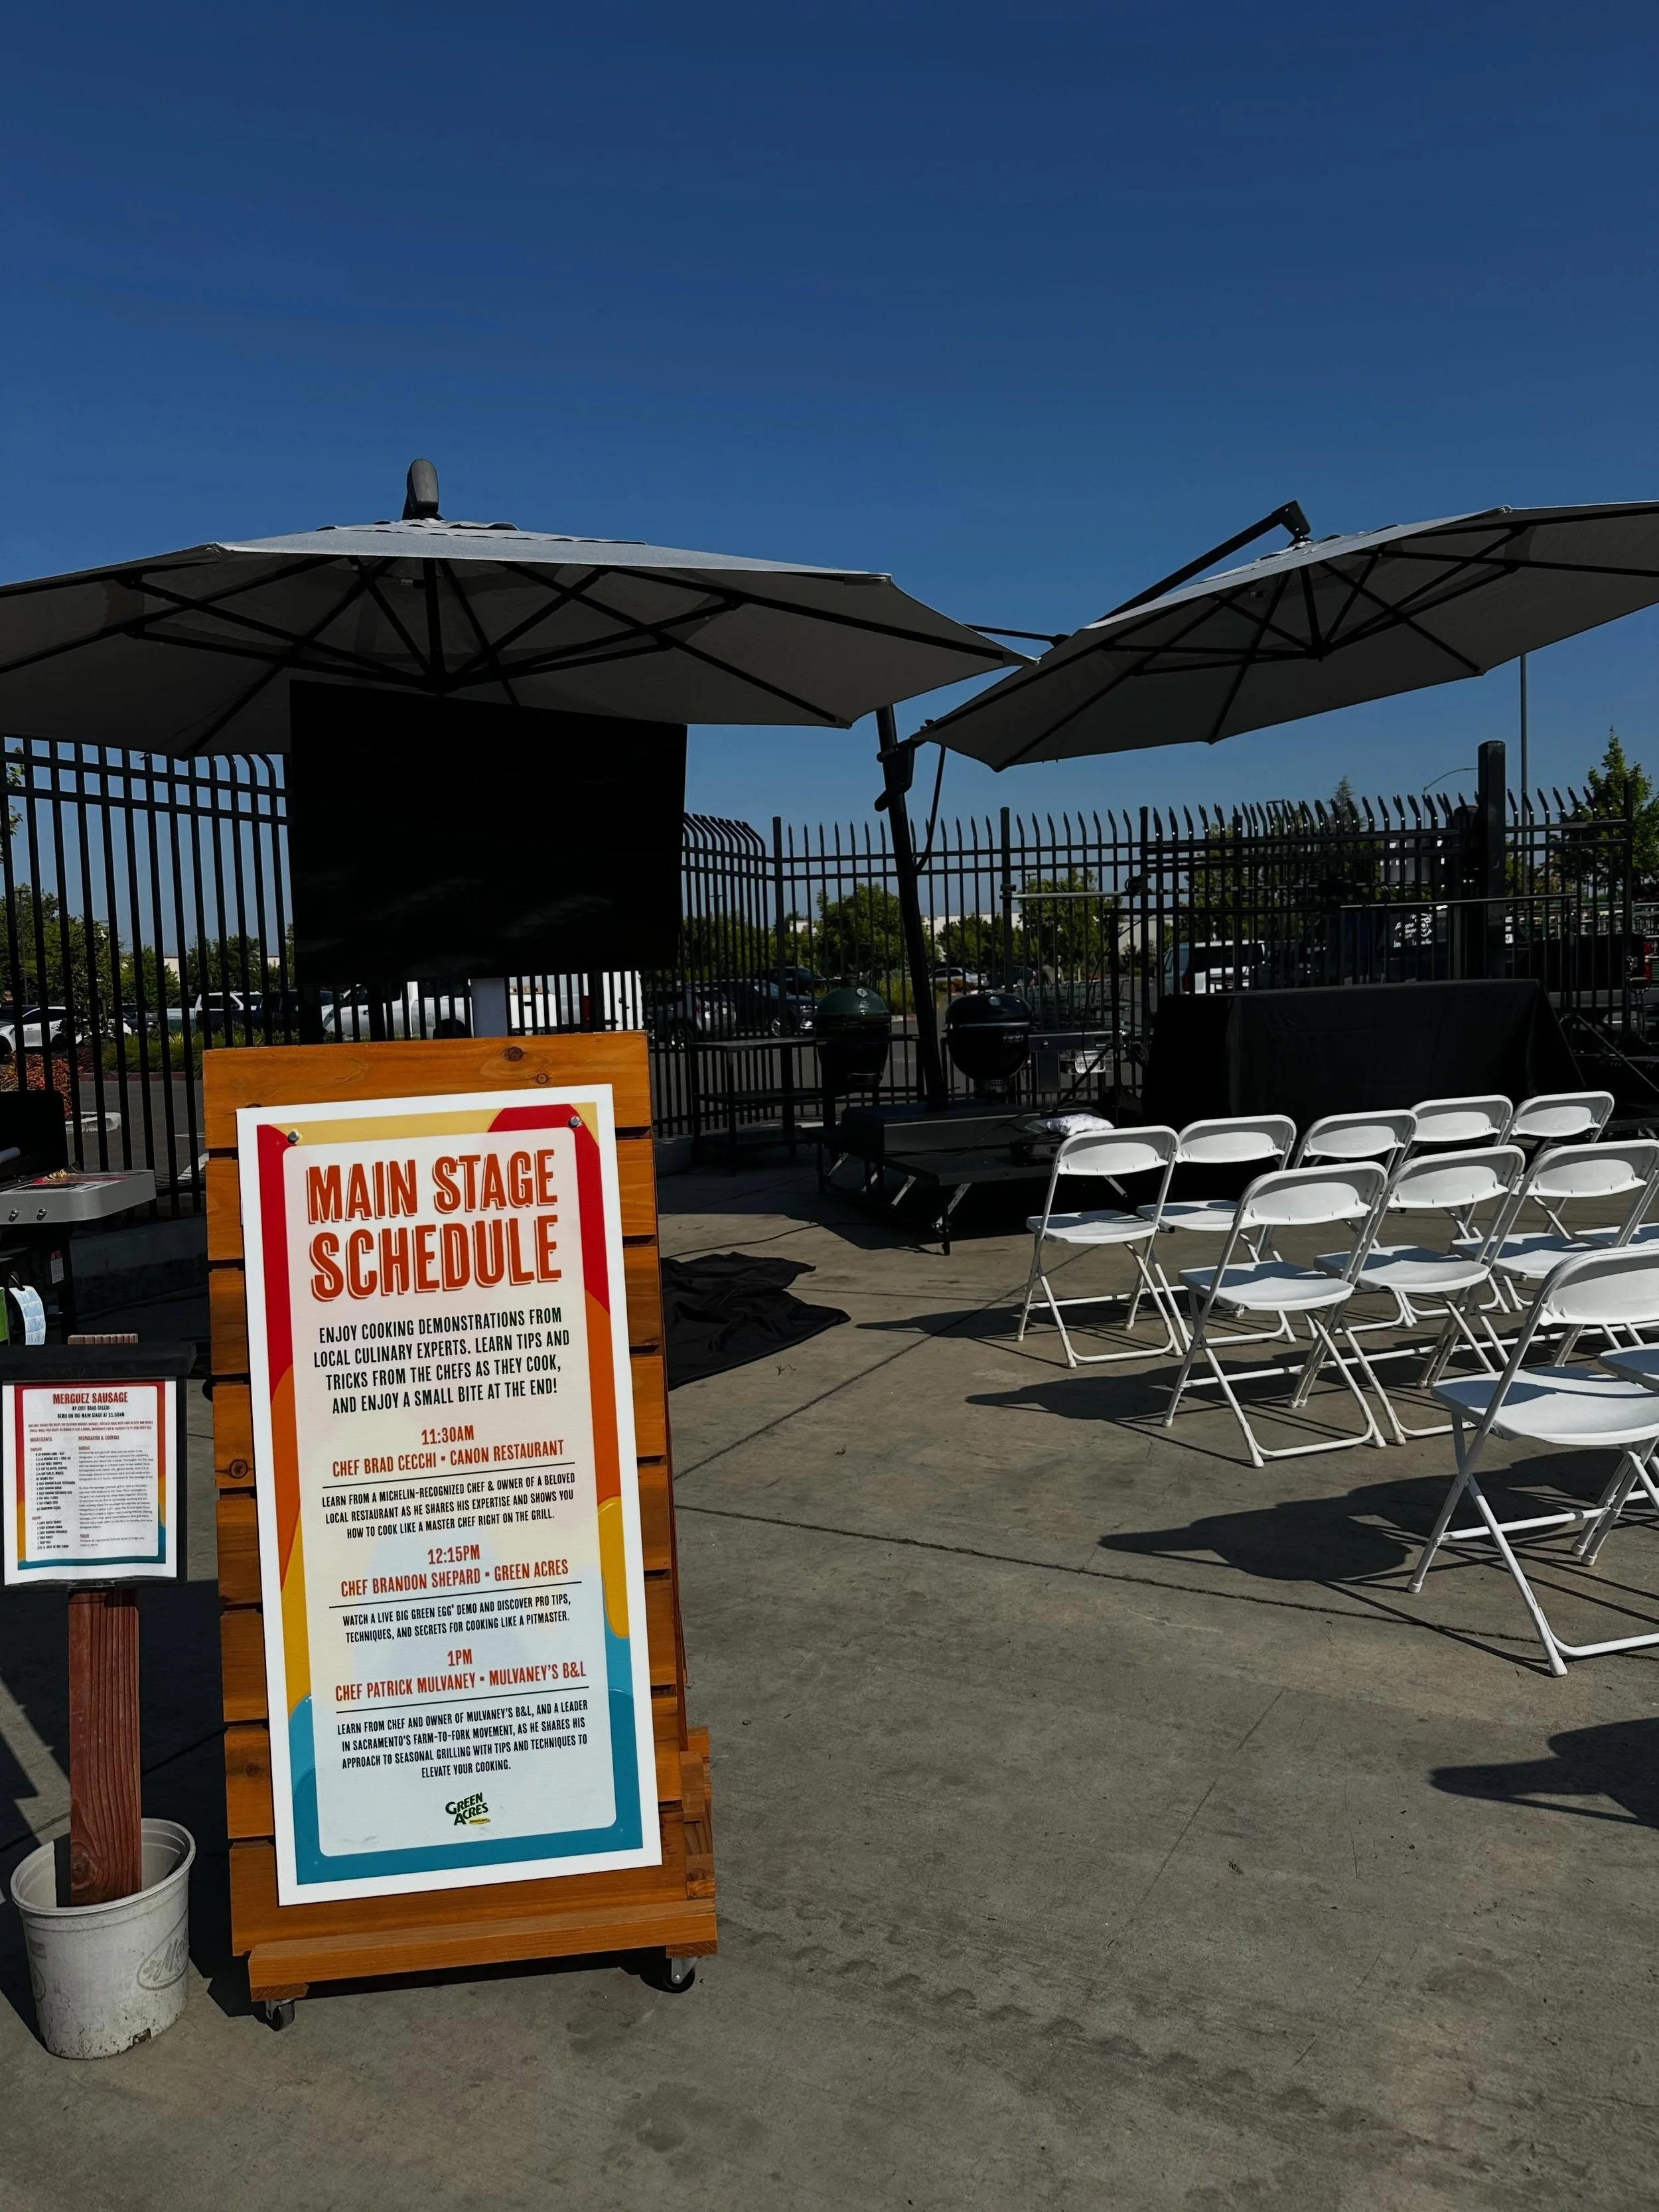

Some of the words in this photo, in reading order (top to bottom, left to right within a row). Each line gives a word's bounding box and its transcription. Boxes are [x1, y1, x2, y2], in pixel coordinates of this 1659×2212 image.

[306, 1159, 417, 1224] MAIN
[432, 1149, 558, 1215] STAGE
[309, 1215, 562, 1303] SCHEDULE
[319, 1325, 357, 1344] ENJOY
[362, 1319, 414, 1340] COOKING
[418, 1310, 526, 1335] DEMONSTRATIONS
[529, 1307, 562, 1325] FROM
[314, 1349, 351, 1368] LOCAL
[354, 1343, 413, 1364] CULINARY
[417, 1339, 471, 1359] EXPERTS.
[475, 1335, 512, 1354] LEARN
[516, 1332, 542, 1350] TIPS
[546, 1329, 570, 1347] AND
[325, 1371, 368, 1391] TRICKS
[372, 1368, 406, 1387] FROM
[409, 1365, 432, 1383] THE
[436, 1362, 472, 1381] CHEFS
[476, 1360, 490, 1377] AS
[494, 1357, 522, 1375] THEY
[526, 1354, 561, 1372] COOK,
[53, 1392, 90, 1404] MERGUEZ
[92, 1392, 128, 1404] SAUSAGE
[332, 1396, 357, 1414] AND
[361, 1392, 399, 1412] ENJOY
[403, 1391, 411, 1408] A
[414, 1387, 455, 1407] SMALL
[458, 1384, 484, 1402] BITE
[488, 1382, 501, 1400] AT
[504, 1380, 526, 1398] THE
[530, 1377, 557, 1396] END!
[421, 1424, 474, 1445] 11:30AM
[332, 1459, 360, 1477] CHEF
[364, 1456, 394, 1475] BRAD
[397, 1452, 437, 1471] CECCHI
[450, 1447, 490, 1466] CANON
[493, 1439, 564, 1462] RESTAURANT
[322, 1495, 346, 1508] LEARN
[348, 1493, 370, 1505] FROM
[372, 1492, 377, 1503] A
[379, 1483, 465, 1503] MICHELIN-RECOGNIZED
[467, 1481, 485, 1494] CHEF
[488, 1481, 495, 1491] &
[497, 1477, 524, 1491] OWNER
[526, 1476, 535, 1488] OF
[537, 1475, 543, 1487] A
[544, 1472, 575, 1486] BELOVED
[325, 1512, 350, 1524] LOCAL
[351, 1507, 399, 1522] RESTAURANT
[401, 1505, 411, 1517] AS
[413, 1504, 423, 1516] HE
[425, 1501, 455, 1514] SHARES
[457, 1499, 470, 1512] HIS
[472, 1495, 511, 1510] EXPERTISE
[513, 1494, 528, 1506] AND
[530, 1491, 557, 1504] SHOWS
[559, 1489, 574, 1501] YOU
[346, 1527, 364, 1539] HOW
[366, 1526, 376, 1538] TO
[378, 1524, 398, 1536] COOK
[399, 1522, 417, 1534] LIKE
[418, 1521, 423, 1532] A
[425, 1518, 456, 1532] MASTER
[457, 1516, 476, 1528] CHEF
[478, 1513, 500, 1526] RIGHT
[502, 1512, 514, 1524] ON
[515, 1511, 530, 1522] THE
[531, 1508, 555, 1520] GRILL.
[427, 1544, 480, 1565] 12:15PM
[341, 1579, 368, 1597] CHEF
[372, 1573, 427, 1594] BRANDON
[431, 1568, 481, 1588] SHEPARD
[494, 1563, 530, 1582] GREEN
[534, 1559, 569, 1578] ACRES
[342, 1613, 368, 1627] WATCH
[370, 1613, 376, 1624] A
[378, 1611, 394, 1623] LIVE
[396, 1609, 409, 1621] BIG
[411, 1607, 435, 1620] GREEN
[457, 1603, 477, 1615] DEMO
[479, 1601, 495, 1613] AND
[497, 1597, 533, 1611] DISCOVER
[535, 1595, 549, 1607] PRO
[551, 1593, 571, 1605] TIPS,
[345, 1628, 395, 1643] TECHNIQUES,
[397, 1626, 412, 1639] AND
[414, 1623, 447, 1637] SECRETS
[449, 1621, 464, 1633] FOR
[466, 1617, 499, 1631] COOKING
[501, 1615, 518, 1628] LIKE
[519, 1615, 525, 1626] A
[526, 1611, 570, 1625] PITMASTER.
[447, 1649, 472, 1667] 1PM
[335, 1683, 363, 1702] CHEF
[367, 1678, 413, 1699] PATRICK
[417, 1672, 476, 1694] MULVANEY
[489, 1664, 559, 1686] MULVANEY'S
[562, 1661, 587, 1679] B&L
[337, 1722, 362, 1735] LEARN
[364, 1720, 385, 1733] FROM
[387, 1718, 405, 1731] CHEF
[408, 1716, 423, 1728] AND
[425, 1714, 453, 1727] OWNER
[455, 1712, 464, 1724] OF
[467, 1707, 514, 1722] MULVANEY'S
[516, 1705, 534, 1718] B&L,
[536, 1703, 551, 1716] AND
[554, 1702, 559, 1714] A
[561, 1699, 588, 1713] LEADER
[342, 1741, 350, 1753] IN
[352, 1734, 411, 1751] SACRAMENTO'S
[413, 1729, 471, 1745] FARM-TO-FORK
[472, 1724, 516, 1739] MOVEMENT,
[518, 1723, 528, 1734] AS
[530, 1722, 540, 1733] HE
[541, 1718, 571, 1732] SHARES
[573, 1717, 586, 1729] HIS
[342, 1755, 381, 1769] APPROACH
[382, 1753, 393, 1765] TO
[394, 1749, 435, 1764] SEASONAL
[436, 1745, 471, 1760] GRILLING
[472, 1743, 492, 1756] WITH
[494, 1741, 512, 1754] TIPS
[514, 1740, 529, 1752] AND
[530, 1735, 577, 1750] TECHNIQUES
[577, 1733, 588, 1745] TO
[421, 1765, 452, 1779] ELEVATE
[453, 1763, 473, 1775] YOUR
[475, 1759, 512, 1773] COOKING.
[445, 1792, 483, 1814] GREEN
[454, 1803, 488, 1826] ACRES
